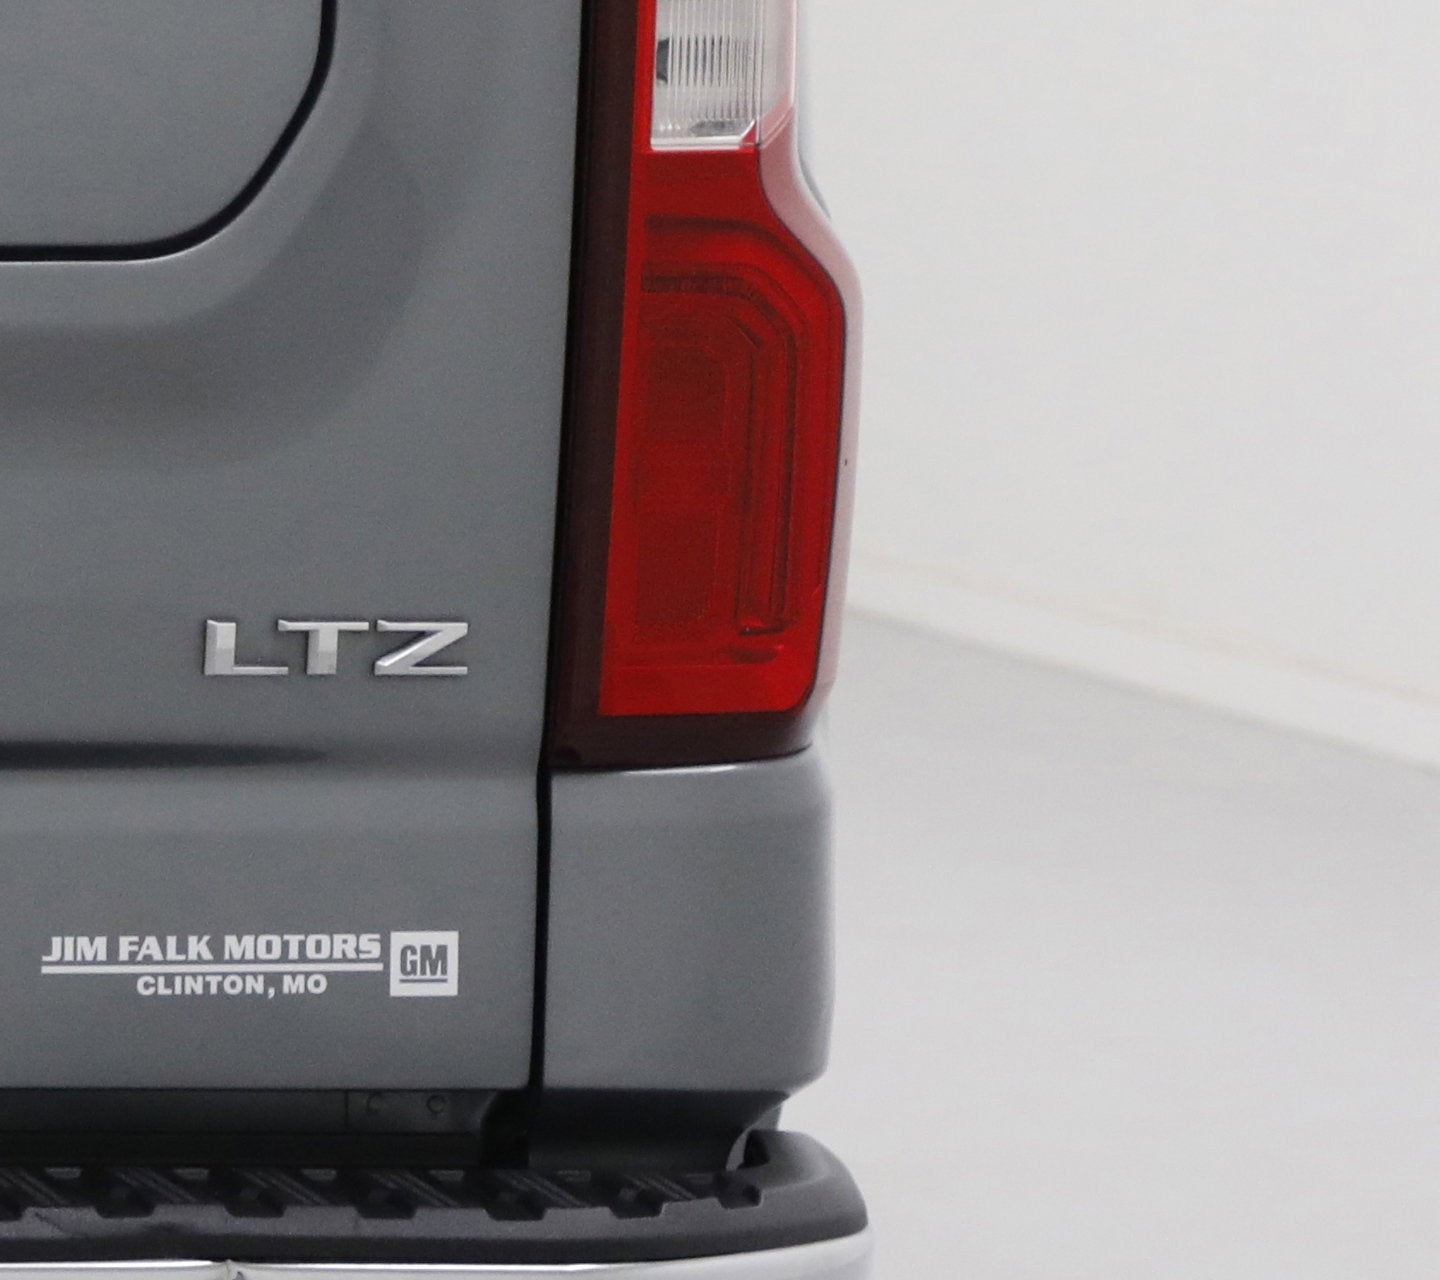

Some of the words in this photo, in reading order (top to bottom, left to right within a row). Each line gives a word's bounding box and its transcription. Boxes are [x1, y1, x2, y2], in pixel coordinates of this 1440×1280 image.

[204, 618, 469, 676] LTZ
[41, 935, 108, 962] JIM
[118, 934, 214, 962] FALK
[223, 933, 382, 961] MOTORS
[399, 943, 449, 977] GM
[136, 974, 276, 999] CLINTON,
[282, 973, 328, 995] MO
